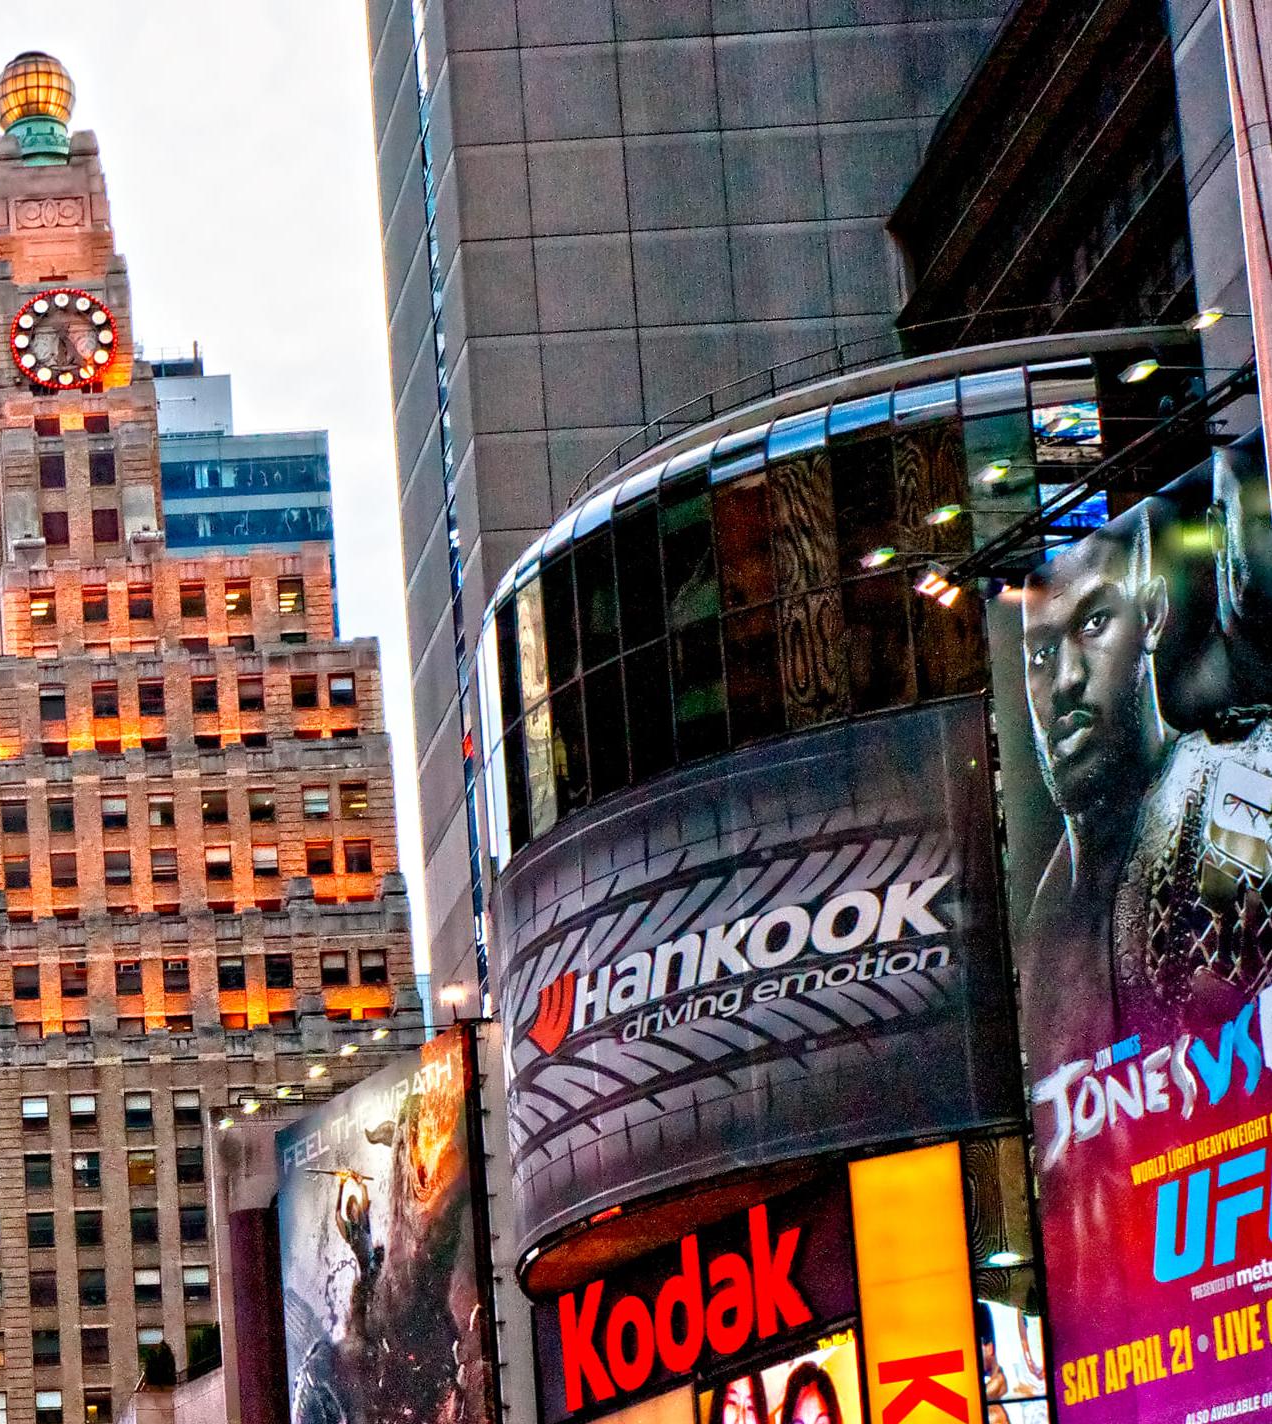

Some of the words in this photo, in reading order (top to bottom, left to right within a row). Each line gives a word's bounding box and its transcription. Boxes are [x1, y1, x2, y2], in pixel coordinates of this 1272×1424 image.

[620, 982, 744, 1046] driving
[751, 943, 951, 1005] emotion
[1190, 1001, 1259, 1107] VS
[282, 1130, 330, 1176] FEEL
[1130, 1159, 1167, 1186] WORLD
[1167, 1143, 1195, 1172] LIGHT
[1196, 1115, 1268, 1162] HEAVYWEIGHT
[1153, 1147, 1272, 1283] UF
[558, 1204, 813, 1414] Kodak
[1061, 1354, 1100, 1406] SAT
[1104, 1334, 1167, 1395] APRIL
[1169, 1325, 1194, 1375] 21
[1213, 1303, 1265, 1362] LIVE
[1210, 1395, 1260, 1422] AVAILABLE
